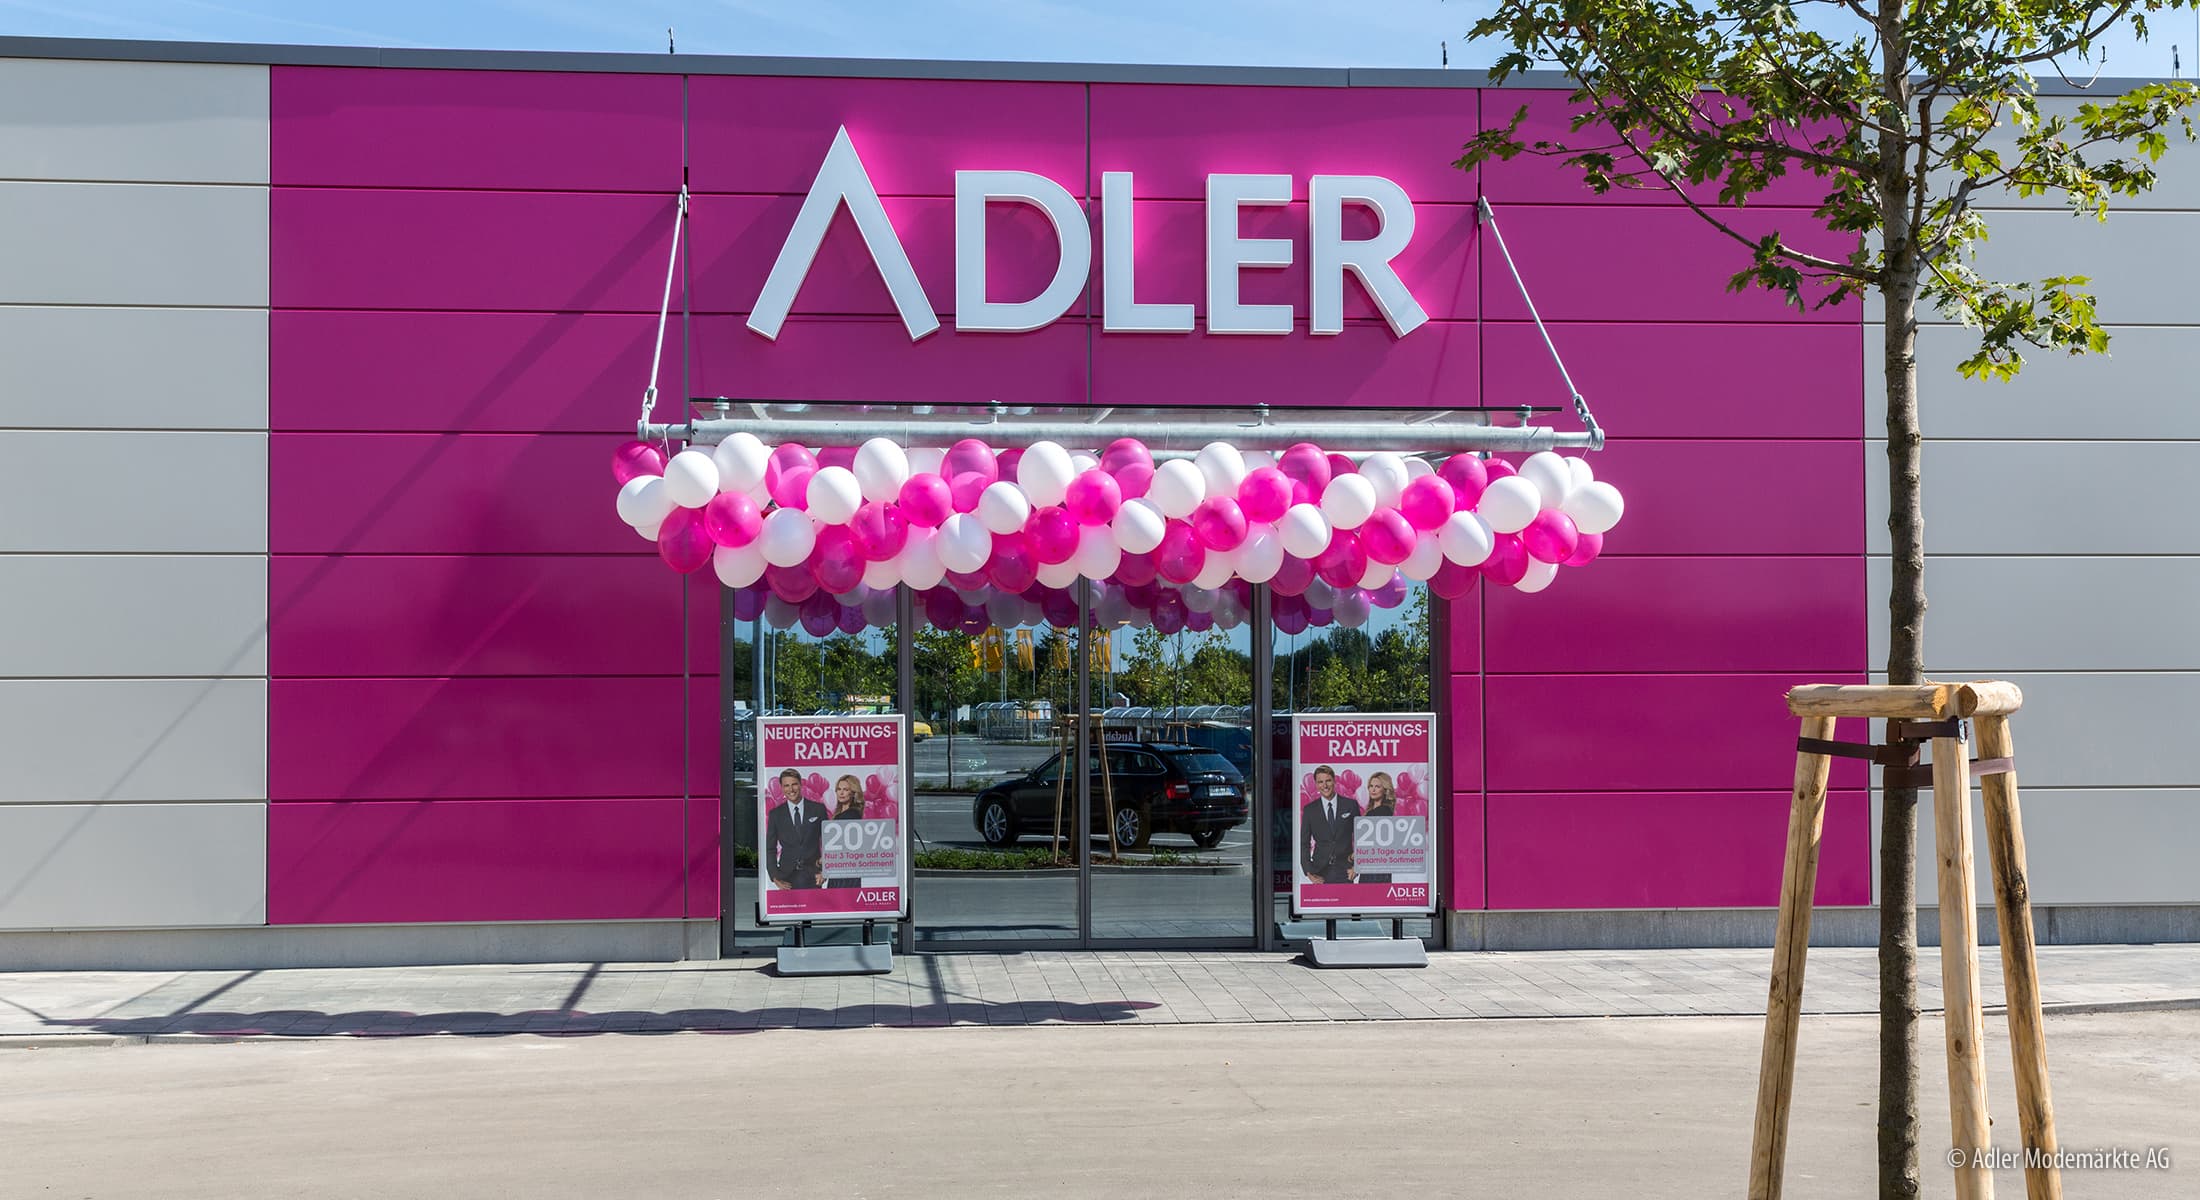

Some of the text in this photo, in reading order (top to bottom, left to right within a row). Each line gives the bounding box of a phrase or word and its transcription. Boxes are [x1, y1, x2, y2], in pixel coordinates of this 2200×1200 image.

[746, 124, 1430, 342] ADLER
[765, 723, 897, 740] NEUERÖFFNUNGS-
[1300, 721, 1427, 737] NEUERÖFFNUNGS-
[794, 741, 869, 760] RABATT
[1328, 739, 1400, 757] RABATT
[824, 821, 894, 850] 20%
[1356, 818, 1424, 846] 20%
[846, 852, 864, 860] Tage
[1377, 848, 1395, 856] Tage
[825, 861, 857, 870] gesamte
[1357, 857, 1388, 865] gesamte
[856, 890, 897, 902] ADLER
[1386, 885, 1425, 898] ADLER
